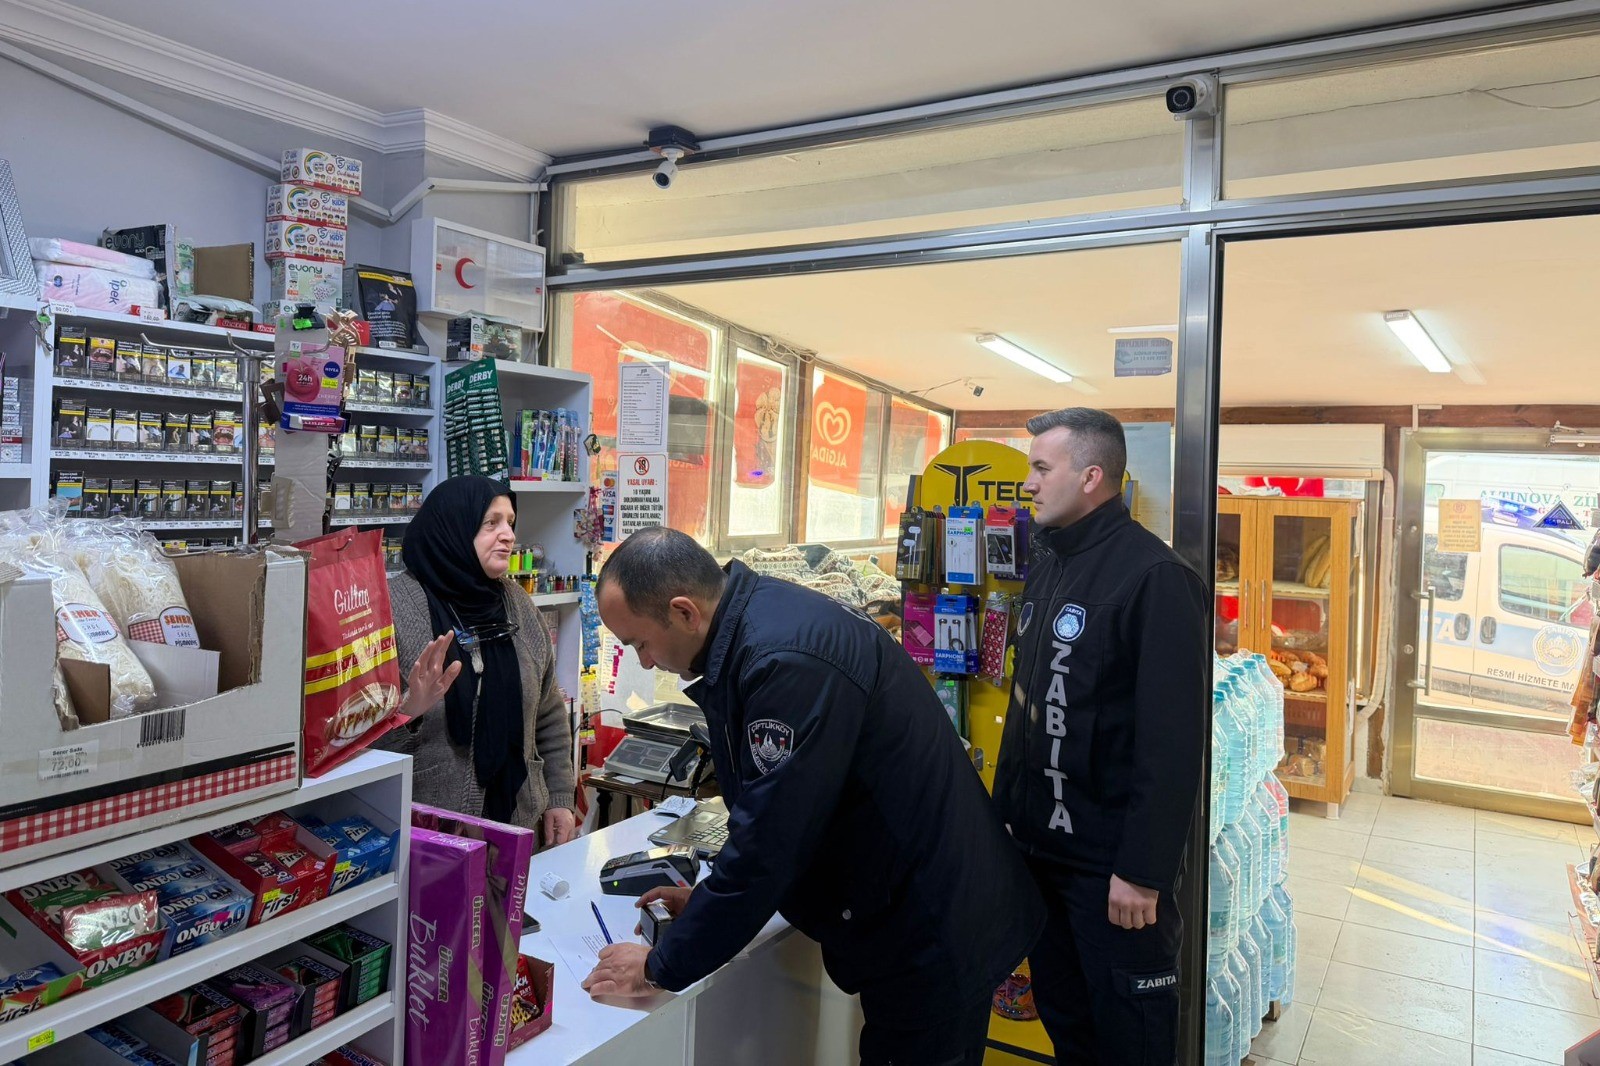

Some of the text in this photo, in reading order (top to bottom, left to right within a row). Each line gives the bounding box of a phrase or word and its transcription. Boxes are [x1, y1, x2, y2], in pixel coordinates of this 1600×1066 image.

[288, 262, 323, 274] evony
[109, 279, 120, 305] ipek
[298, 374, 313, 382] 24h
[447, 378, 466, 394] DERBY
[469, 370, 493, 384] DERBY
[334, 584, 370, 615] Gültaç
[1064, 606, 1083, 616] ZABITA
[935, 651, 964, 661] EARPHONE
[1487, 667, 1515, 680] RESMİ
[1518, 672, 1559, 688] HİZMETE
[1044, 641, 1074, 834] ZABITA
[347, 824, 371, 840] First
[278, 850, 308, 867] First
[133, 872, 180, 893] ONEO
[334, 860, 369, 887] First
[19, 872, 86, 901] ONEO
[509, 871, 527, 924] Buklet
[160, 893, 208, 915] ONEO
[262, 887, 301, 917] First
[176, 919, 220, 944] ONEO
[472, 895, 485, 950] ÜLKER
[86, 941, 153, 979] ONEO
[408, 910, 438, 1033] Buklet
[438, 945, 454, 1003] ÜLKER
[1137, 974, 1177, 989] ZABITA
[494, 992, 511, 1047] ÜLKER
